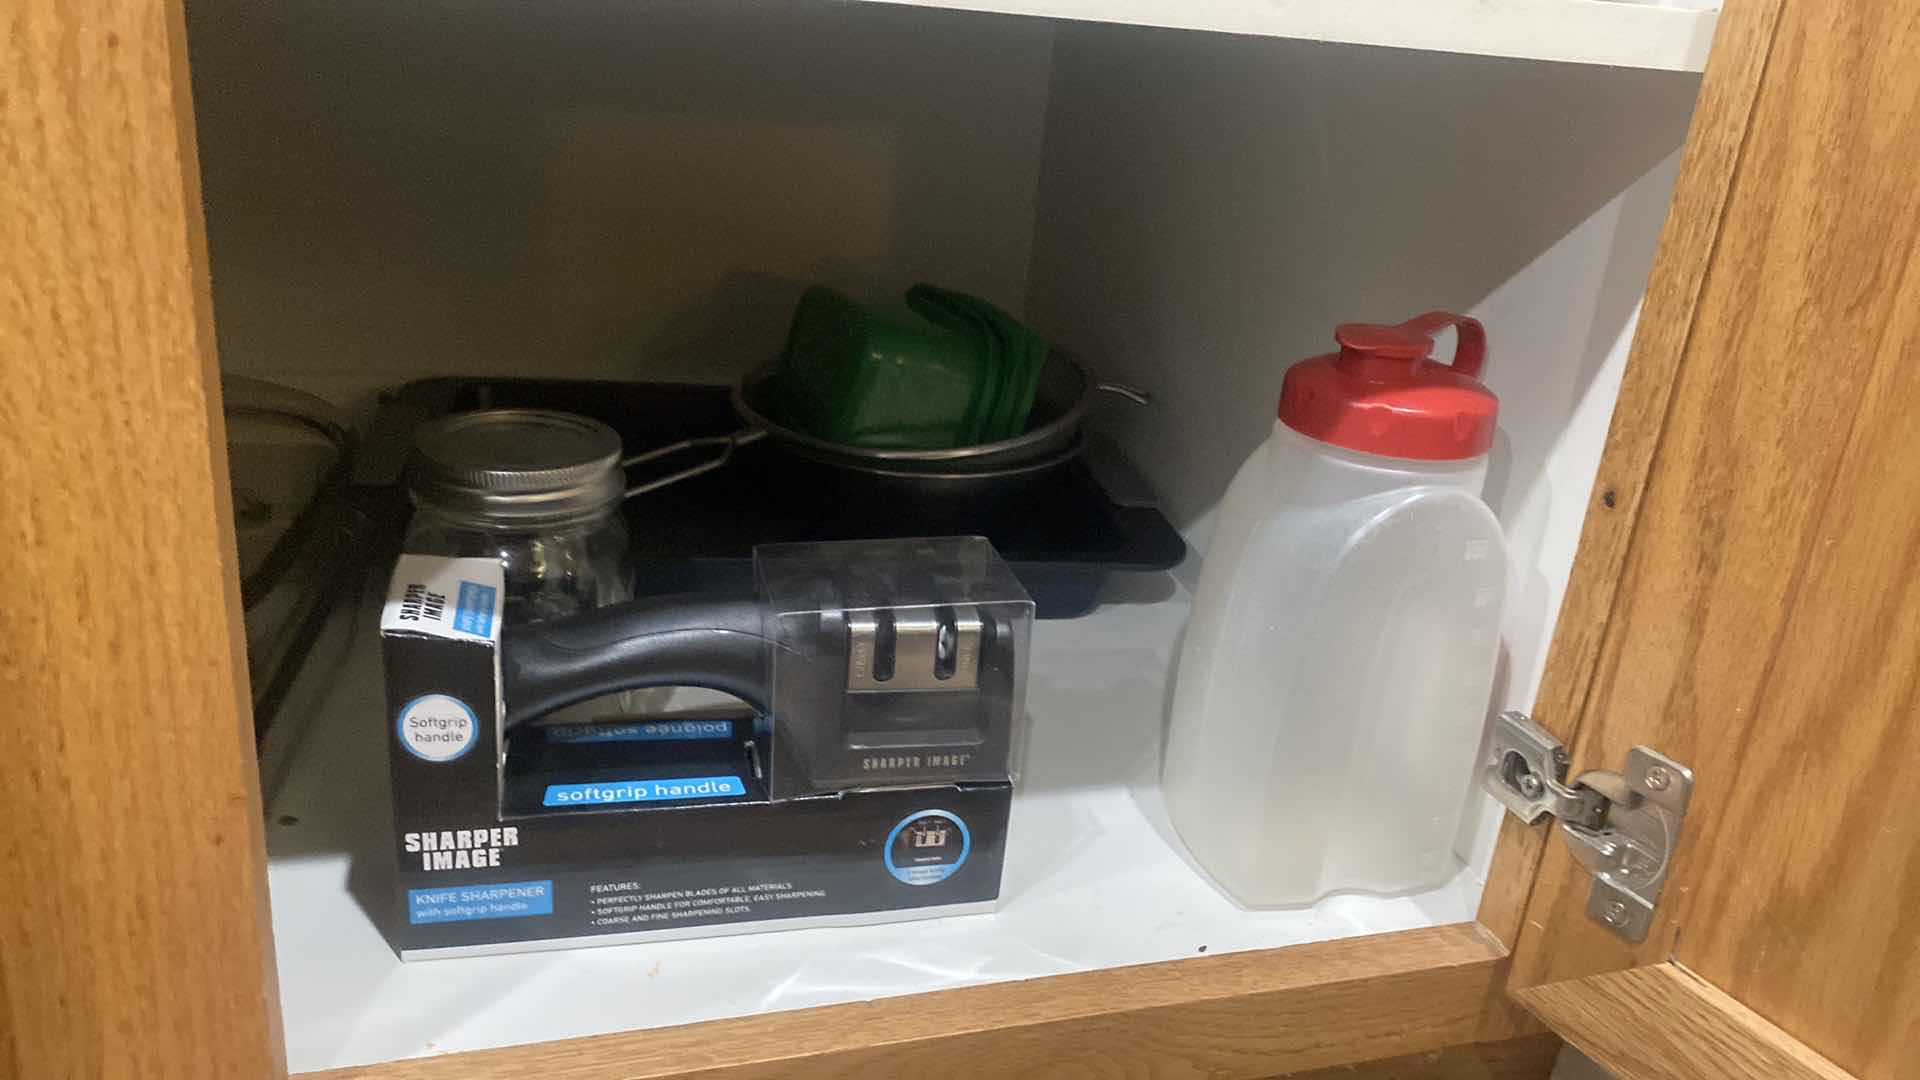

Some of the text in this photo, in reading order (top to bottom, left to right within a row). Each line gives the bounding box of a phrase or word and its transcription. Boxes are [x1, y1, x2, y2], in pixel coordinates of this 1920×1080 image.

[400, 584, 425, 621] SHARPER
[423, 593, 445, 621] IMAGE
[409, 716, 467, 730] Softgrip
[415, 731, 463, 742] handle
[864, 757, 921, 769] SHARPER
[557, 781, 731, 801] softgrip handle
[404, 827, 518, 852] SHARPER
[422, 848, 501, 871] IMAGE
[416, 885, 545, 904] KNIFE SHARPENER
[590, 882, 641, 893] FEATURES:
[597, 895, 642, 905] PERFECTLY
[644, 891, 683, 901] SHARPEN
[685, 888, 717, 898] BLADES
[719, 887, 729, 895] OF
[731, 886, 746, 894] ALL
[416, 900, 528, 918] with softgrip handle
[640, 901, 673, 911] HANDLE
[674, 900, 691, 908] FOR
[753, 893, 773, 902] EASY
[776, 889, 826, 900] SHARPENING
[596, 904, 750, 926] COARSE AND FINE SHARPENING SLOTS
